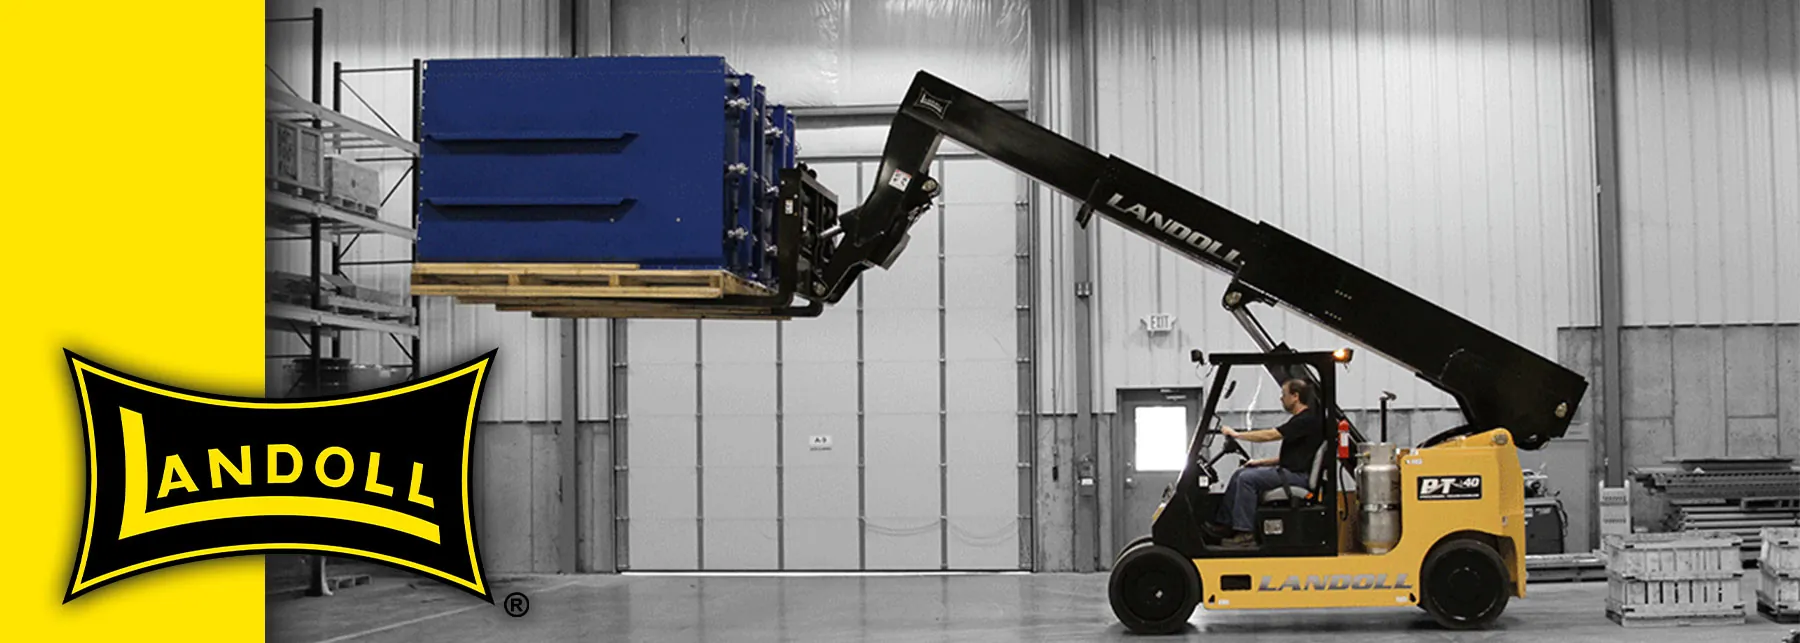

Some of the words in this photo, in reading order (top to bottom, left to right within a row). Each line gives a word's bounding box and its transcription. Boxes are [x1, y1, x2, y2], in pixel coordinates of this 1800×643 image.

[1106, 193, 1242, 265] LANDOLL
[1151, 315, 1169, 329] EXIT
[1257, 573, 1413, 591] LANDOLL
